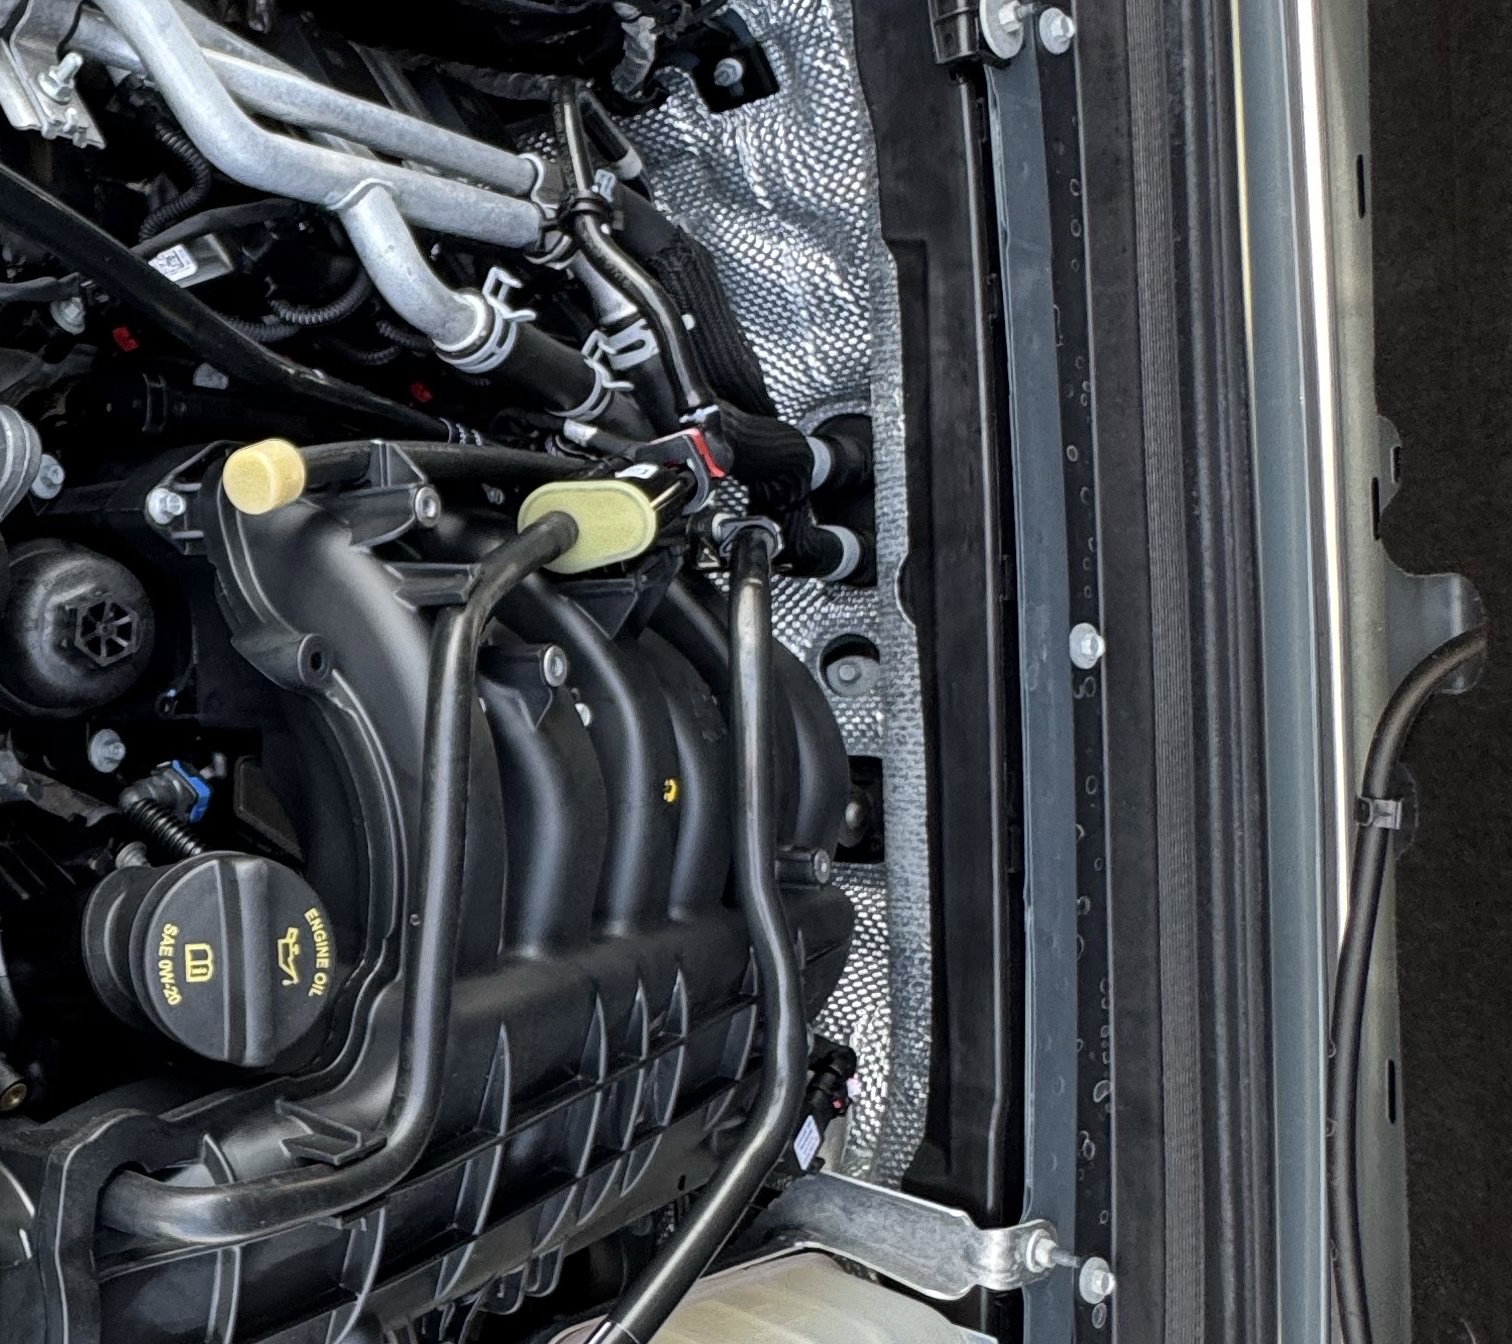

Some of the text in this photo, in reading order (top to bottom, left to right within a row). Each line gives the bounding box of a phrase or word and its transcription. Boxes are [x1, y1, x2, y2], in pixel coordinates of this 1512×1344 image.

[157, 923, 183, 1006] SAE 0W-20
[303, 908, 330, 999] ENGINE OIL
